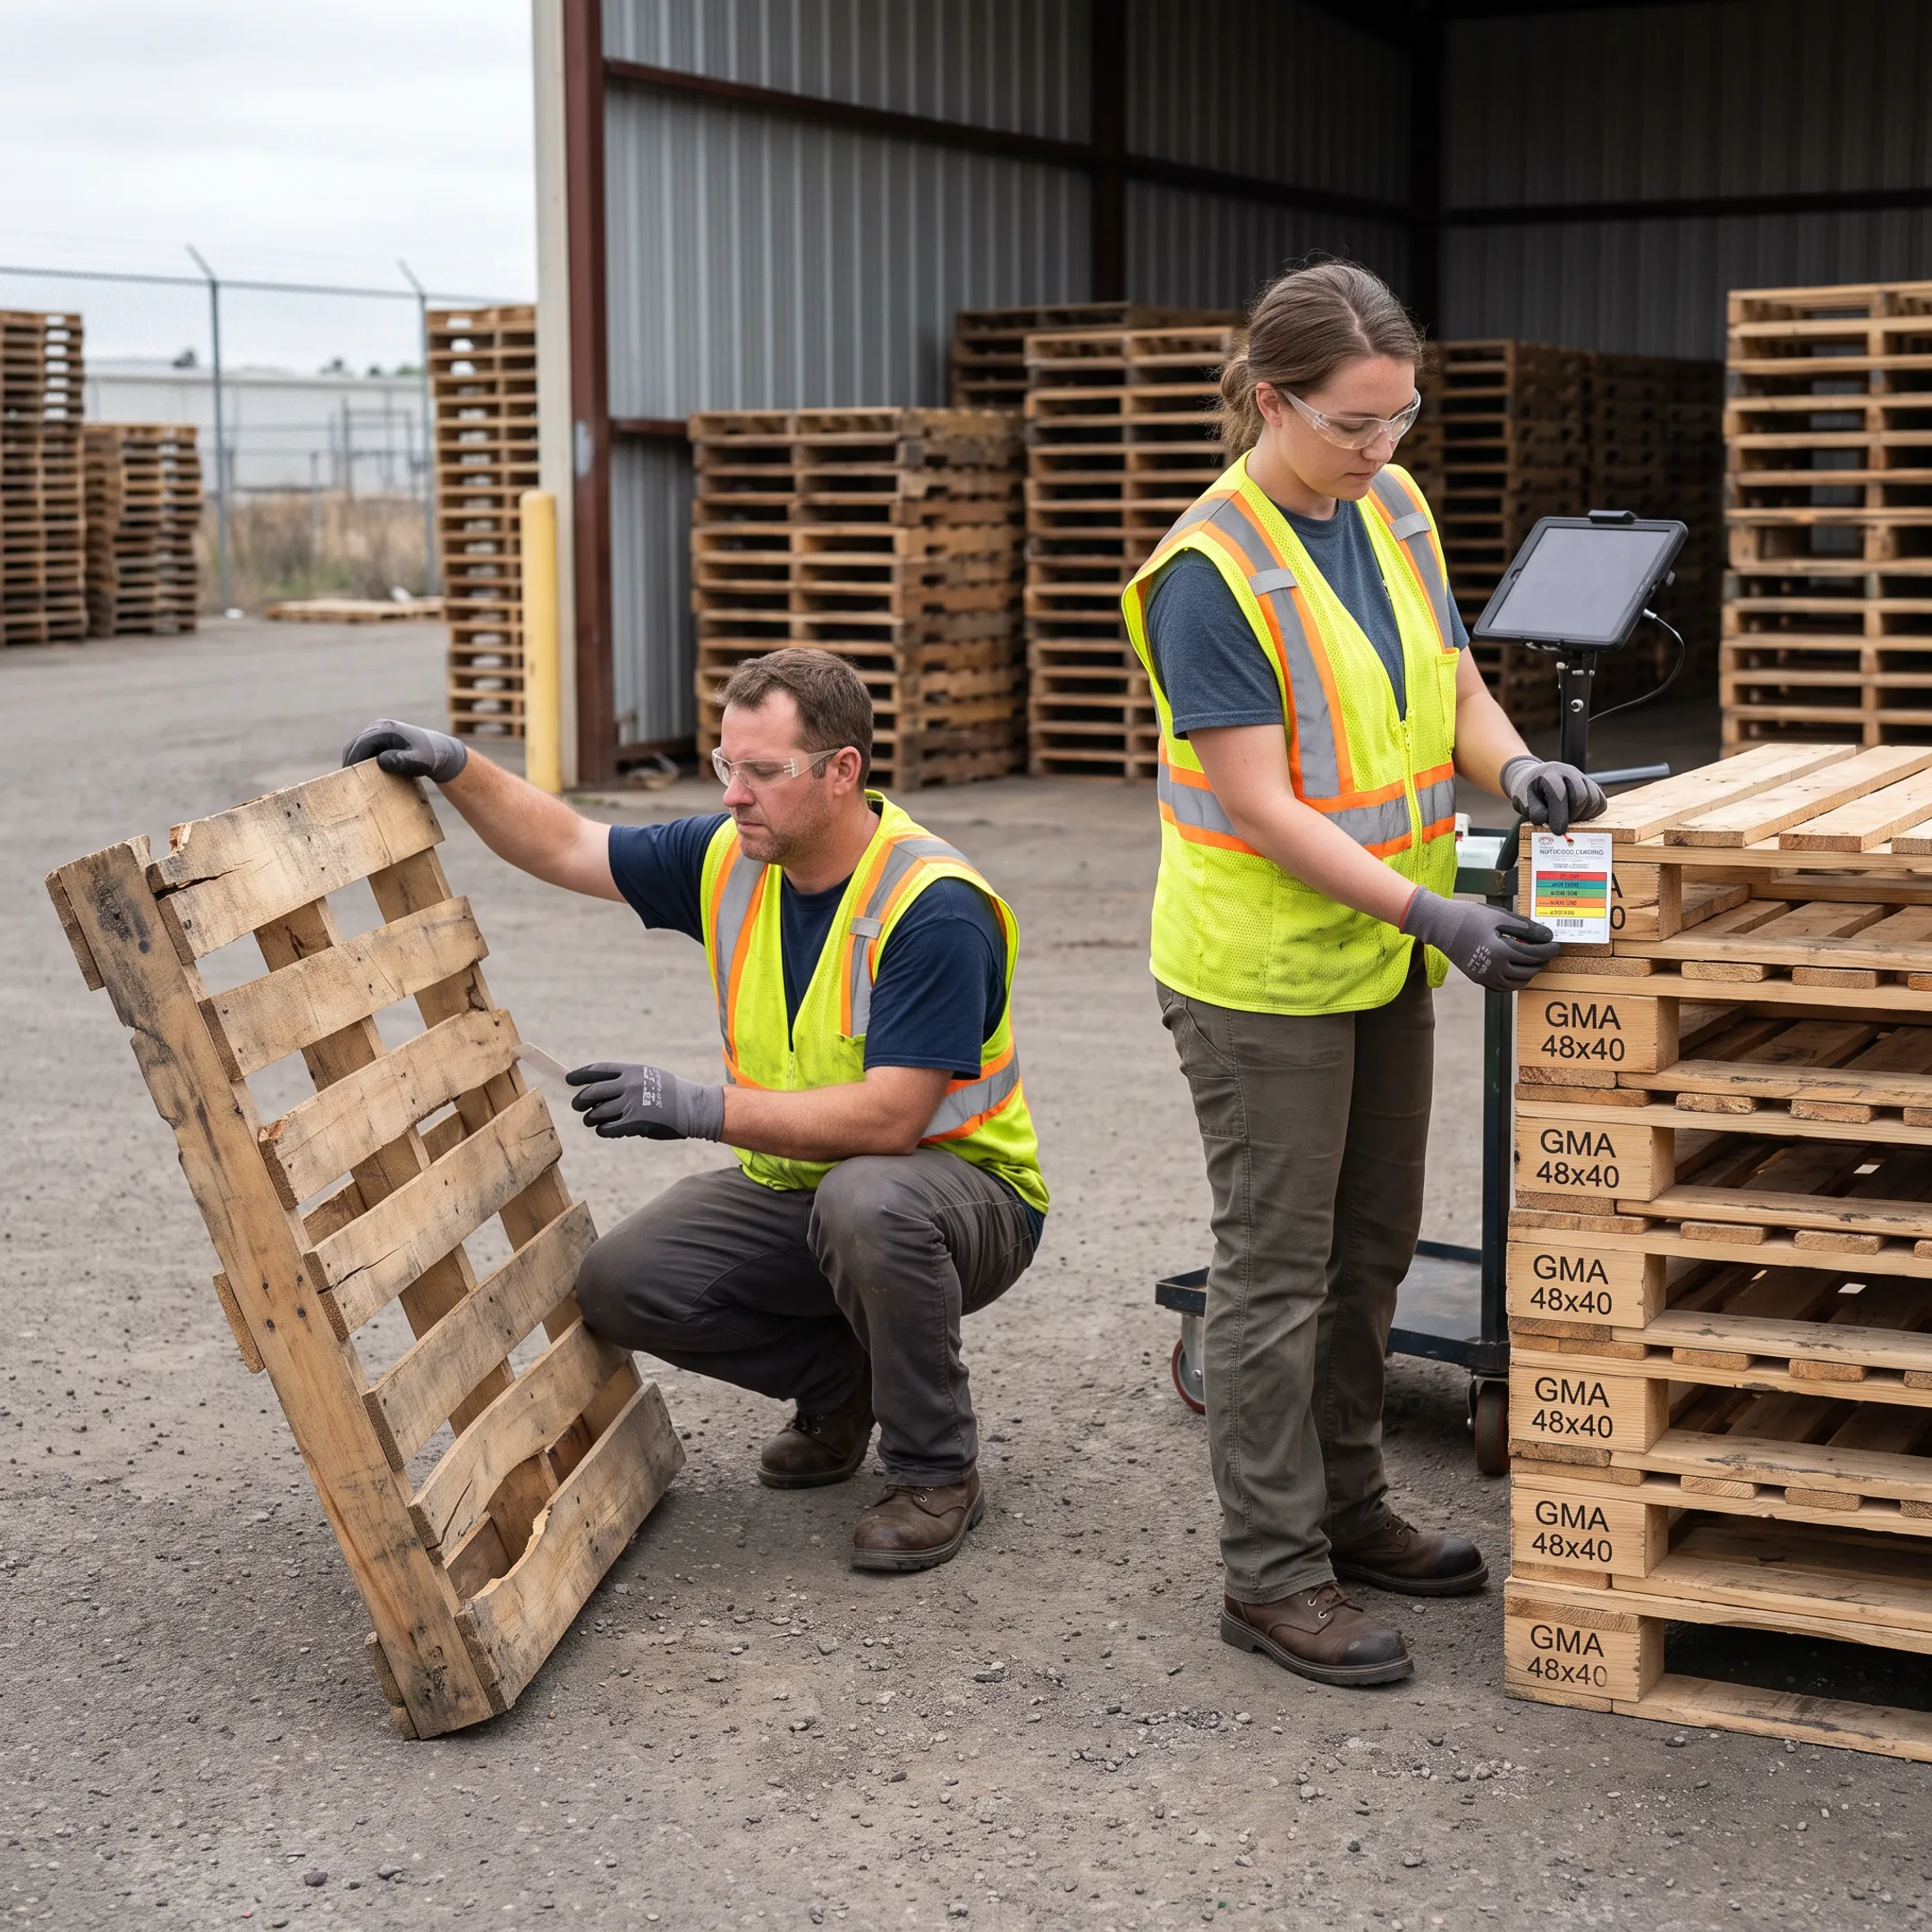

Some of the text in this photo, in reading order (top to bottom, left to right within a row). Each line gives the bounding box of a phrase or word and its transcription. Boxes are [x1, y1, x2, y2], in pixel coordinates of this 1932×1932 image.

[1545, 1001, 1622, 1030] GMA
[1540, 1034, 1625, 1062] 48x40
[1540, 1128, 1617, 1158] GMA
[1536, 1160, 1620, 1189] 48x40
[1533, 1254, 1609, 1285] GMA
[1530, 1286, 1613, 1316] 48x40
[1534, 1377, 1610, 1409] GMA
[1531, 1409, 1614, 1439] 48x40
[1535, 1500, 1610, 1533] GMA
[1531, 1531, 1613, 1563] 48x40
[1530, 1624, 1605, 1658] GMA
[1527, 1656, 1608, 1688] 48x40
